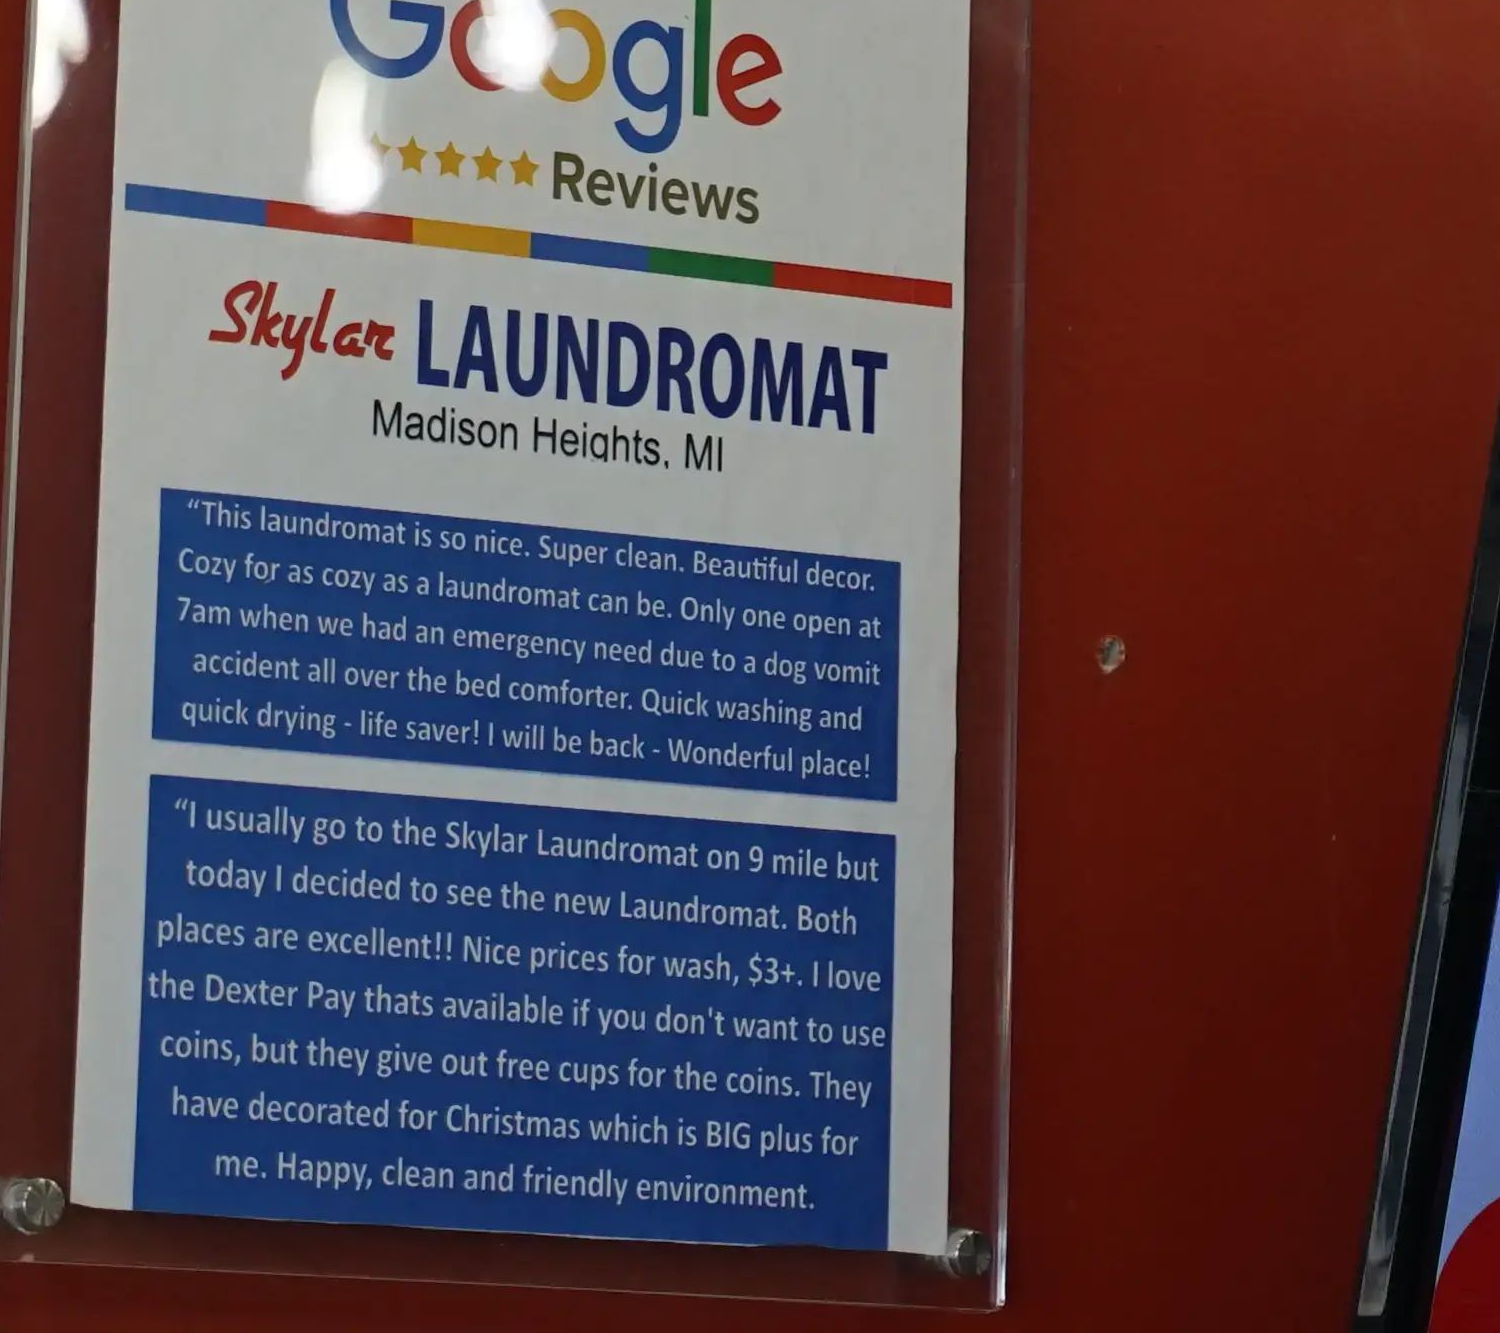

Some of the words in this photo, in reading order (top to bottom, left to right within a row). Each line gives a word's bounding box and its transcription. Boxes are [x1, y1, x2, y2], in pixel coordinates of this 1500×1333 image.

[550, 149, 761, 225] Reviews
[207, 278, 396, 380] Skylar
[415, 298, 890, 436] LAUNDROMAT
[371, 398, 519, 452] Madison
[531, 415, 671, 471] Heights,
[684, 431, 724, 473] MI
[259, 503, 407, 545] laundromat
[413, 520, 432, 548] is
[438, 529, 467, 551] so
[473, 527, 530, 557] nice.
[537, 533, 609, 568] Super
[614, 540, 685, 573] clean.
[692, 549, 799, 584] Beautiful
[804, 559, 875, 592] decor.
[177, 546, 237, 584] Cozy
[243, 551, 281, 584] for
[286, 563, 314, 585] as
[320, 566, 376, 597] cozy
[381, 572, 409, 594] as
[415, 575, 430, 596] a
[437, 570, 581, 610] laundromat
[586, 592, 629, 615] can
[635, 589, 672, 619] be.
[679, 595, 736, 631] Only
[741, 607, 786, 630] one
[791, 612, 851, 639] open
[857, 615, 882, 639] at
[176, 595, 231, 626] 7am
[238, 602, 309, 633] when
[316, 614, 354, 637] we
[361, 610, 407, 642] had
[414, 623, 445, 645] an
[451, 627, 587, 664] emergency
[592, 638, 653, 665] need
[659, 639, 705, 669] due
[710, 647, 736, 672] to
[742, 654, 756, 674] a
[763, 649, 807, 685] dog
[812, 659, 881, 686] vomit
[191, 649, 300, 681] accident
[306, 656, 336, 685] all
[343, 666, 400, 689] over
[405, 665, 447, 694] the
[454, 668, 501, 699] bed
[507, 677, 633, 711] comforter.
[640, 687, 709, 718] Quick
[715, 696, 813, 733] washing
[817, 704, 863, 731] and
[180, 696, 249, 728] quick
[255, 700, 336, 739] drying
[359, 708, 398, 738] life
[404, 718, 479, 745] saver!
[487, 721, 494, 747] I
[500, 723, 545, 751] will
[552, 725, 582, 754] be
[588, 728, 645, 760] back
[666, 736, 793, 772] Wonderful
[800, 748, 870, 780] place!
[205, 804, 306, 844] usually
[311, 816, 346, 846] go
[353, 814, 384, 843] to
[390, 814, 437, 847] the
[444, 819, 529, 859] Skylar
[536, 827, 699, 868] Laundromat
[705, 848, 740, 871] on
[747, 844, 764, 873] 9
[771, 847, 828, 878] mile
[835, 849, 879, 883] but
[184, 857, 267, 898] today
[274, 863, 283, 892] I
[291, 863, 401, 901] decided
[408, 875, 438, 904] to
[445, 883, 492, 908] see
[498, 879, 545, 912] the
[553, 891, 611, 917] new
[619, 889, 787, 930] Laundromat.
[796, 903, 857, 936] Both
[156, 911, 245, 948] places
[253, 925, 299, 951] are
[306, 925, 452, 961] excellent!!
[462, 934, 521, 966] Nice
[529, 939, 609, 974] prices
[616, 943, 656, 976] for
[662, 951, 740, 987] wash,
[747, 951, 803, 988] $3+.
[811, 959, 819, 988] I
[826, 959, 882, 992] love
[146, 967, 195, 1001] the
[203, 972, 299, 1007] Dexter
[306, 979, 356, 1019] Pay
[362, 982, 434, 1017] thats
[441, 991, 564, 1026] available
[571, 997, 591, 1027] if
[596, 1006, 646, 1036] you
[653, 1002, 725, 1037] don't
[731, 1015, 799, 1042] want
[804, 1016, 834, 1044] to
[841, 1023, 886, 1048] use
[159, 1028, 241, 1067] coins,
[250, 1031, 299, 1065] but
[305, 1035, 370, 1077] they
[375, 1041, 433, 1078] give
[440, 1050, 489, 1077] out
[495, 1047, 550, 1081] free
[557, 1060, 620, 1091] cups
[626, 1056, 667, 1088] for
[672, 1059, 718, 1092] the
[724, 1065, 801, 1097] coins.
[808, 1069, 873, 1109] They
[171, 1084, 239, 1120] have
[247, 1089, 390, 1128] decorated
[396, 1098, 439, 1131] for
[445, 1102, 581, 1140] Christmas
[587, 1111, 669, 1145] which
[676, 1116, 698, 1147] is
[705, 1119, 751, 1150] BIG
[758, 1122, 813, 1158] plus
[819, 1124, 859, 1156] for
[214, 1153, 267, 1179] me.
[276, 1150, 373, 1191] Happy,
[380, 1155, 454, 1189] clean
[462, 1162, 514, 1193] and
[521, 1163, 629, 1206] friendly
[634, 1173, 815, 1210] environment.
